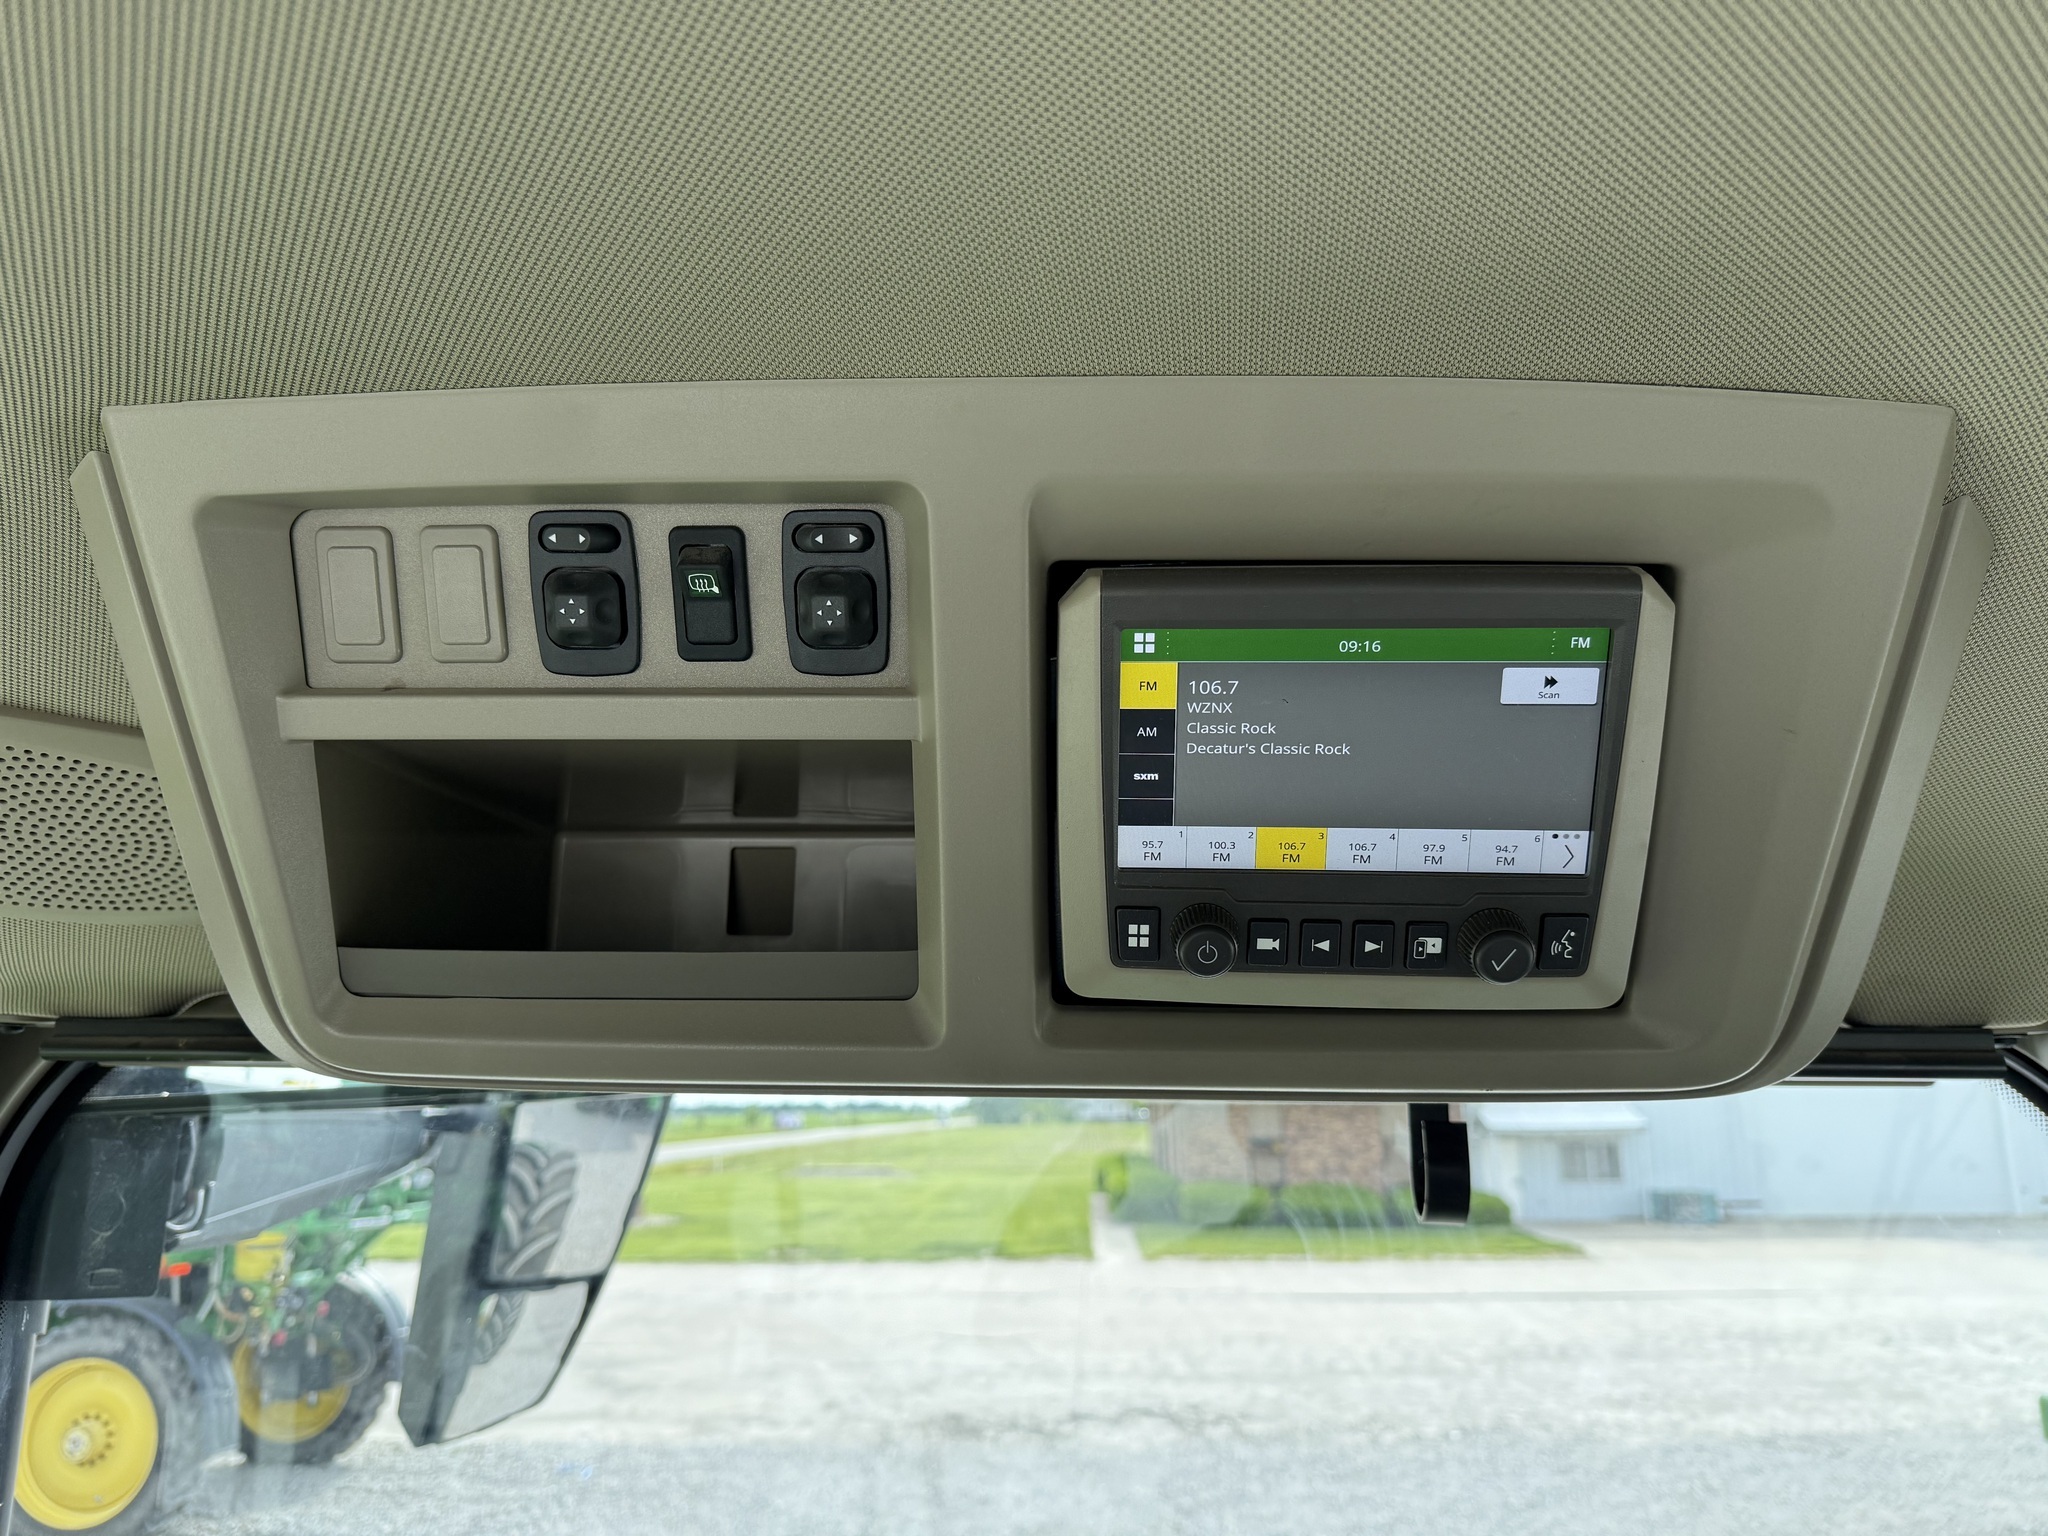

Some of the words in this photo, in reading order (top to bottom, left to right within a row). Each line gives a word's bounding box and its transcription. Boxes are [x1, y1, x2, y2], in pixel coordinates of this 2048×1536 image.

[1339, 640, 1381, 652] 09:16
[1570, 636, 1591, 649] FM
[1139, 681, 1157, 691] FM
[1188, 680, 1239, 695] 106.7
[1538, 691, 1560, 699] Scan
[1187, 702, 1233, 714] WZNX
[1137, 727, 1157, 737] AM
[1186, 722, 1236, 735] Classic
[1241, 722, 1276, 735] Rock
[1186, 742, 1256, 755] Decatur's
[1260, 742, 1310, 755] Classic
[1315, 743, 1351, 756] Rock
[1133, 772, 1159, 781] sxm
[1248, 831, 1254, 839] 2
[1318, 832, 1325, 840] 3
[1389, 832, 1396, 841] 4
[1461, 833, 1468, 842] 5
[1534, 834, 1541, 843] 6
[1142, 840, 1164, 849] 95.7
[1208, 841, 1236, 850] 100.3
[1278, 842, 1306, 851] 106.7
[1348, 843, 1377, 852] 106.7
[1423, 844, 1446, 853] 97.9
[1495, 845, 1518, 854] 94.7
[1143, 851, 1162, 861] FM
[1212, 852, 1231, 862] FM
[1282, 853, 1300, 863] FM
[1352, 854, 1371, 864] FM
[1424, 855, 1443, 865] FM
[1496, 856, 1515, 866] FM
